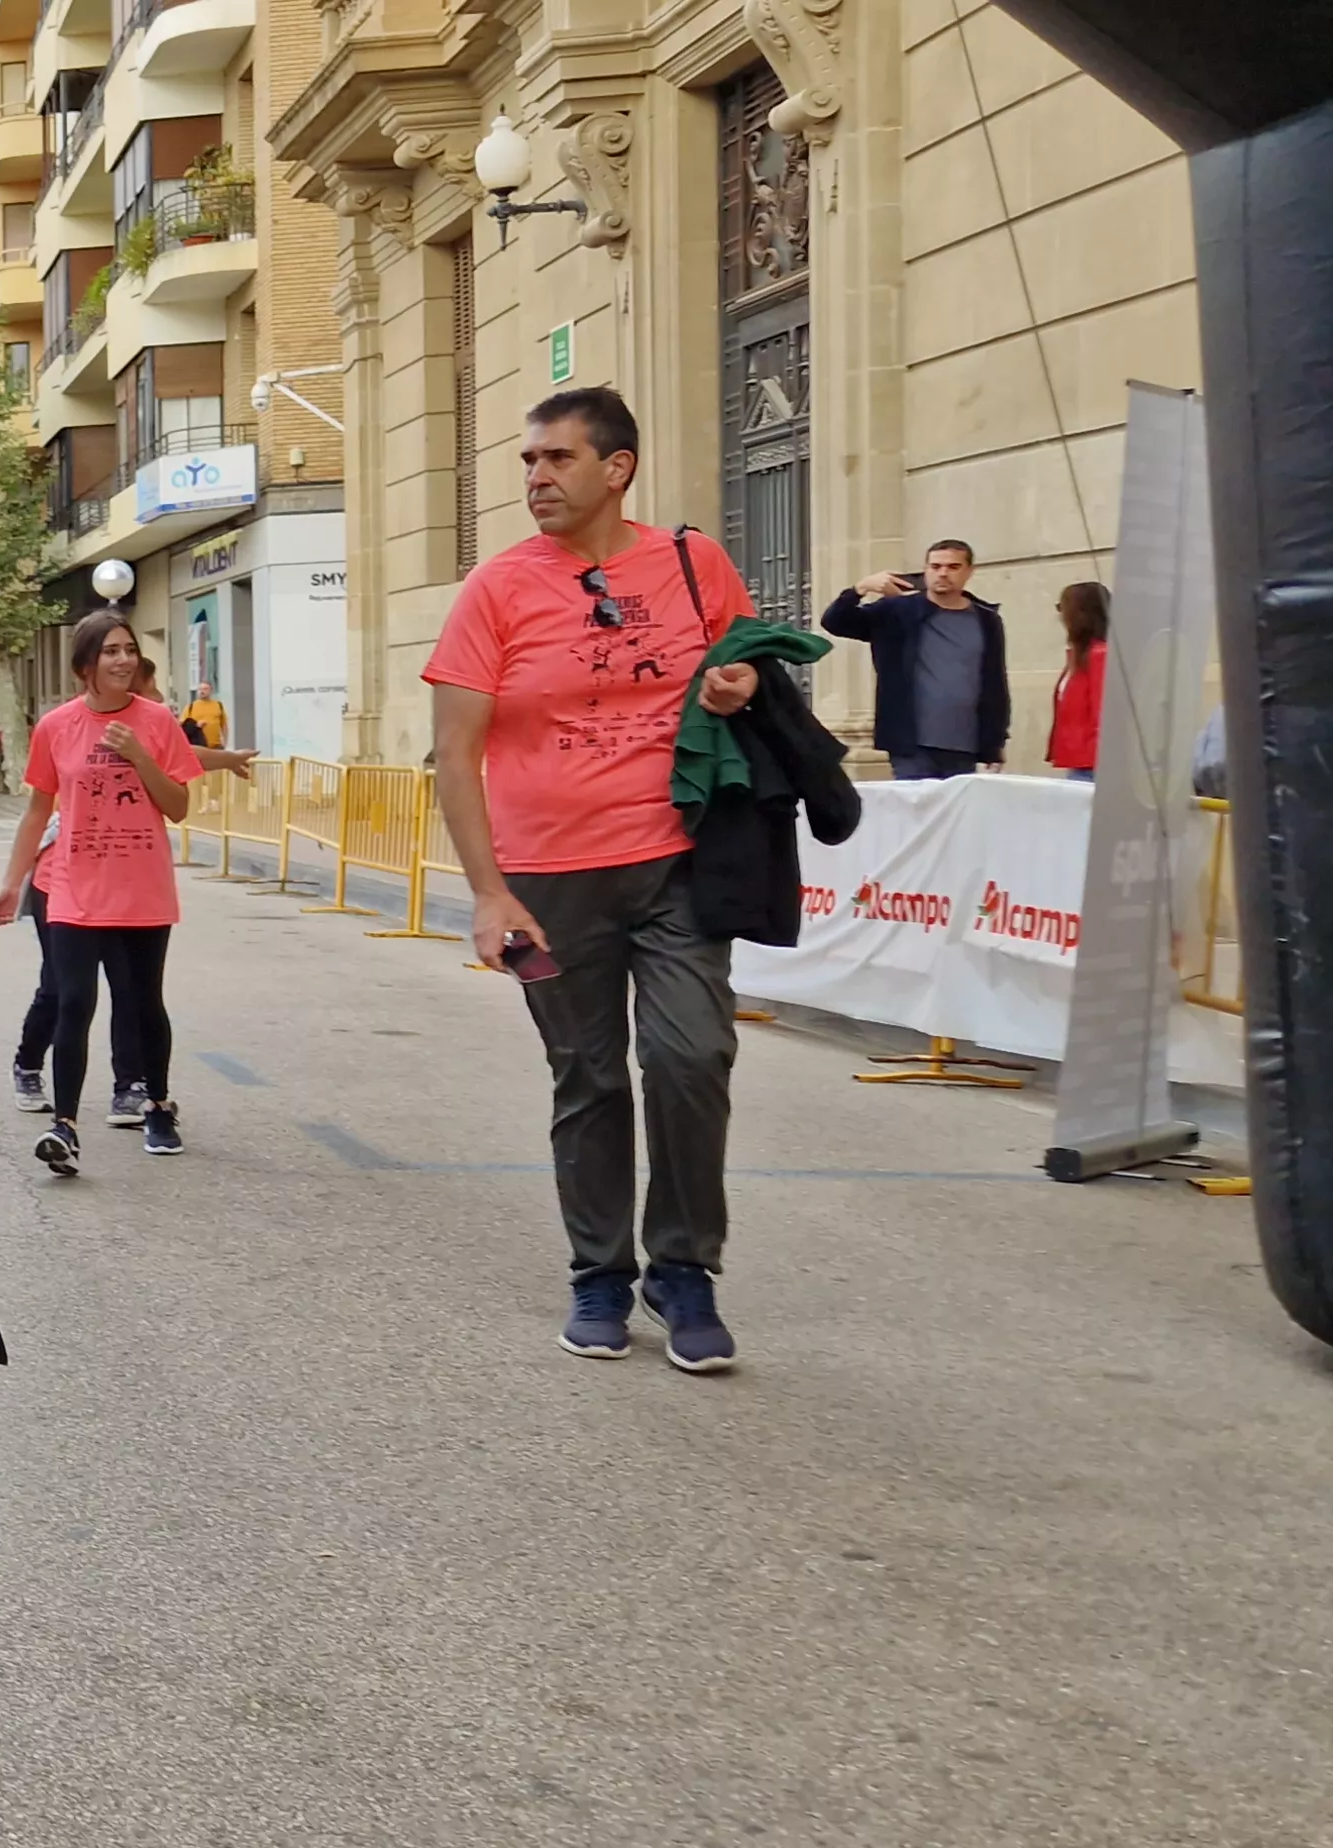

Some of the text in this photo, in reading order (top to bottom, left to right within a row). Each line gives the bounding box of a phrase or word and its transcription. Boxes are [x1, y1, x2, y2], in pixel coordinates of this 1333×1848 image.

[310, 572, 347, 587] SMY
[852, 876, 951, 934] Alcampo
[977, 880, 1081, 956] Alcamp
